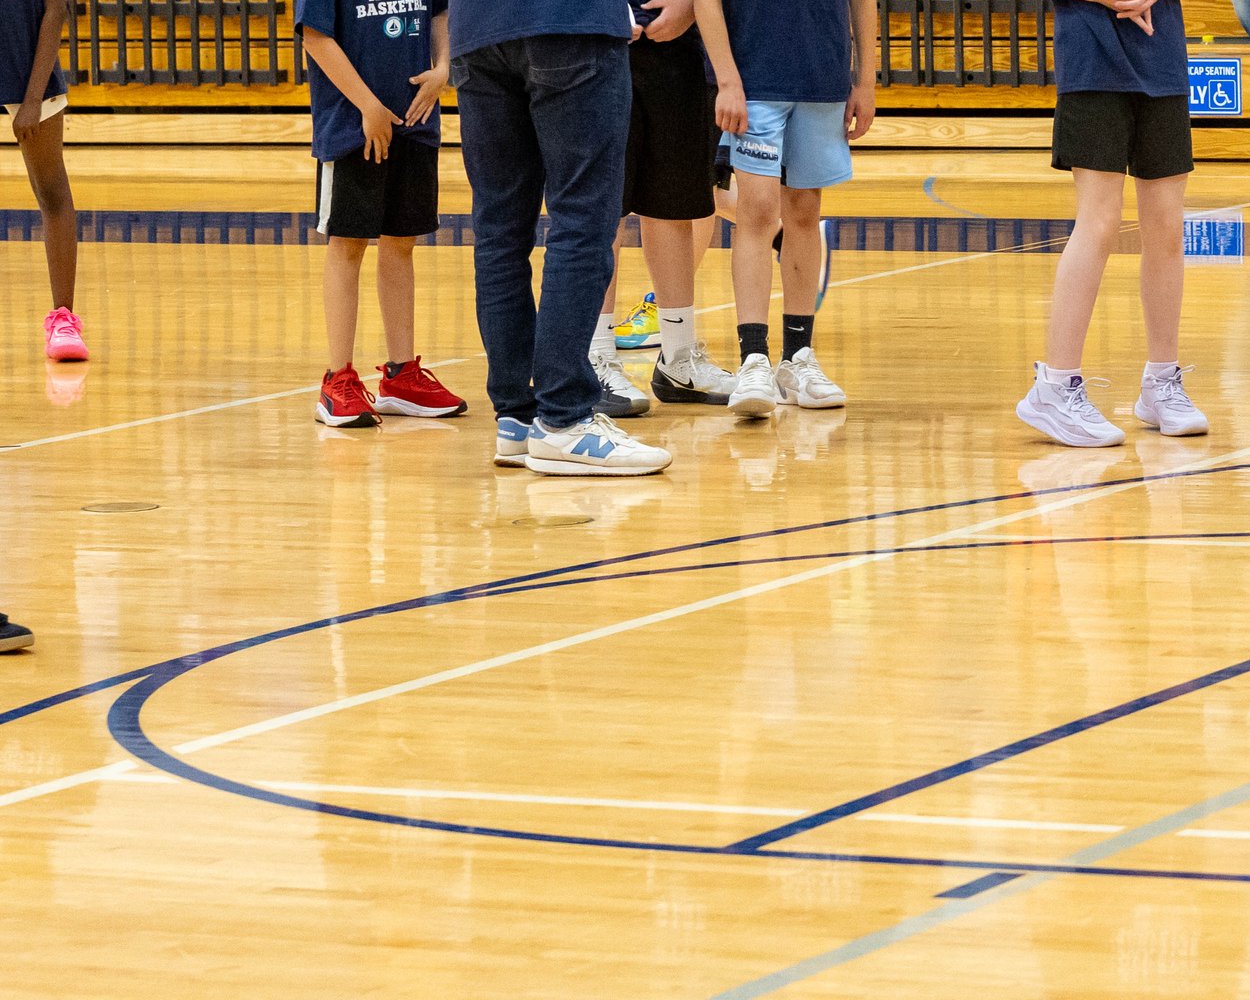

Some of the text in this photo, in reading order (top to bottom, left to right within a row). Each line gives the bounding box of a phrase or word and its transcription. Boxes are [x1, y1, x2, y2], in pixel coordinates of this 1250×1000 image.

[1205, 66, 1236, 75] SEATING
[1190, 85, 1208, 104] LY
[736, 146, 779, 162] ARMOUR
